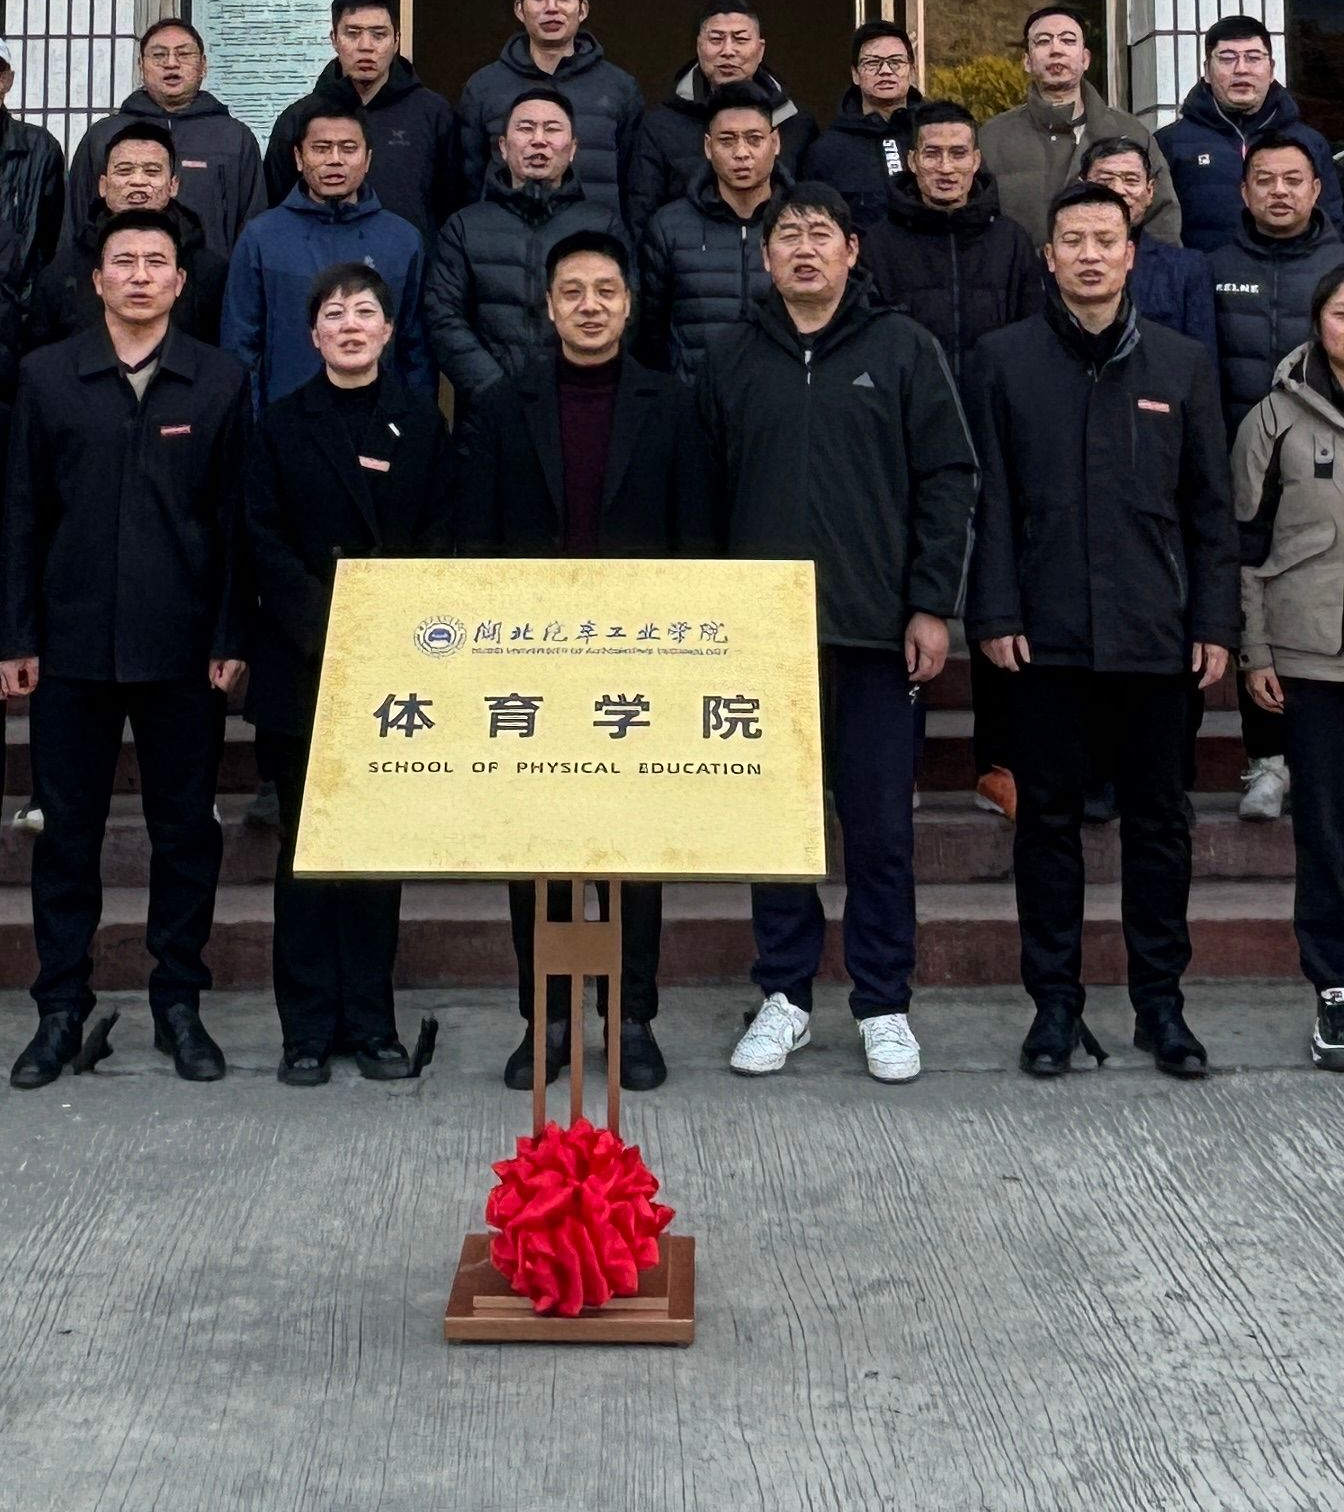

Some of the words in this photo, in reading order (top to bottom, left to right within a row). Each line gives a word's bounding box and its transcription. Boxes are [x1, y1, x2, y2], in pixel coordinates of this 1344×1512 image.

[372, 692, 764, 740] 体育学院
[367, 760, 455, 774] SCHOOL
[471, 760, 499, 774] OF
[516, 761, 622, 775] PHYSICAL
[638, 761, 763, 776] EDUCATION
